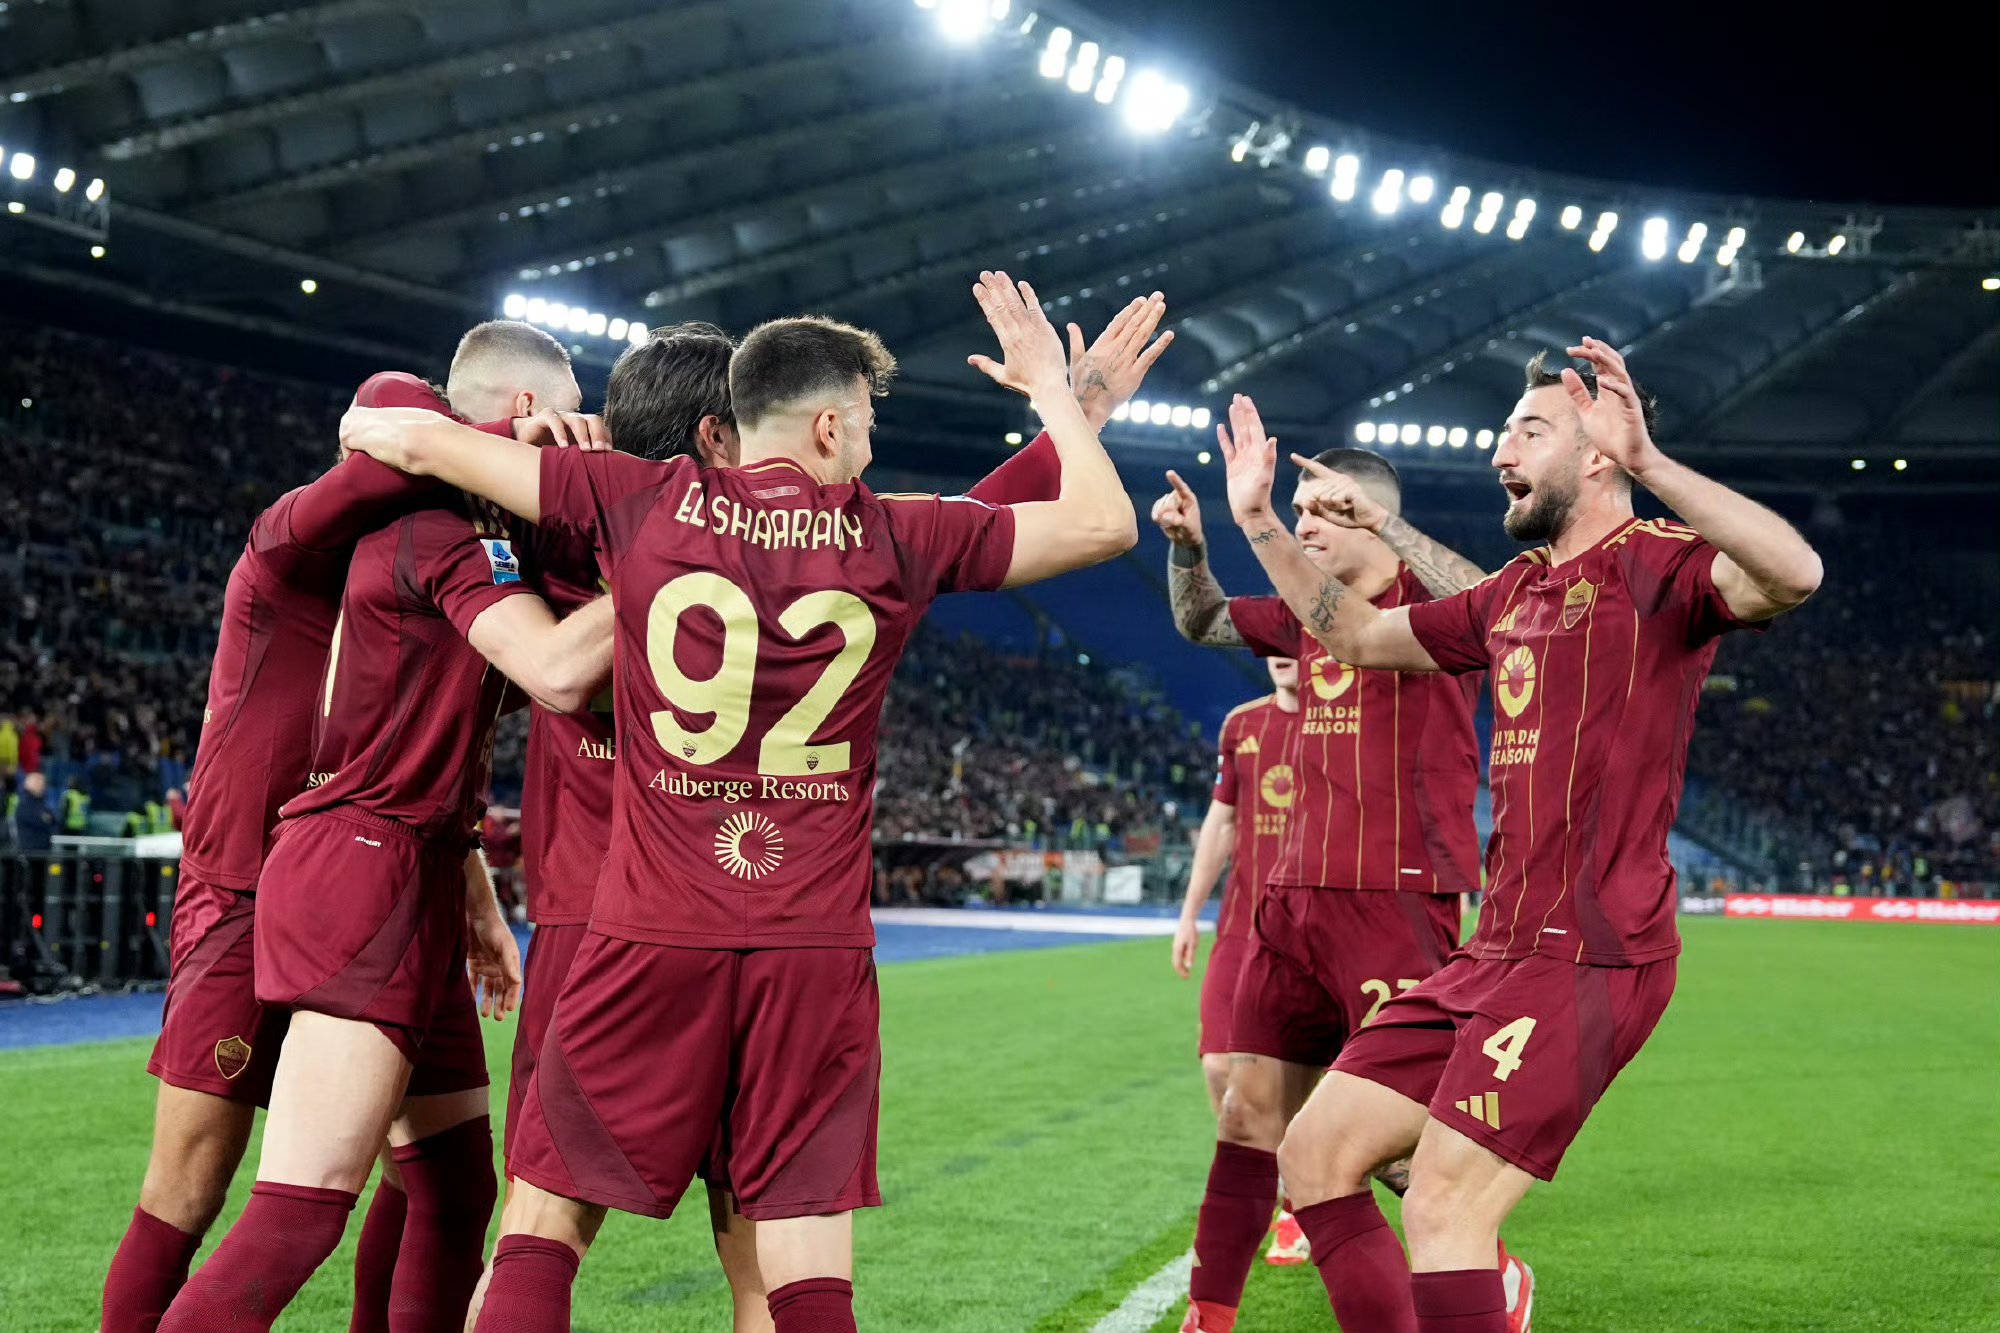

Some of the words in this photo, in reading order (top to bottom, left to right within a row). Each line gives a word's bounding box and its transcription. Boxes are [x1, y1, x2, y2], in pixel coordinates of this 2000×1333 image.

[674, 481, 706, 528] EL
[647, 571, 877, 775] 92
[649, 769, 753, 803] Auberge
[760, 776, 850, 801] Resorts
[1482, 1016, 1537, 1082] 4
